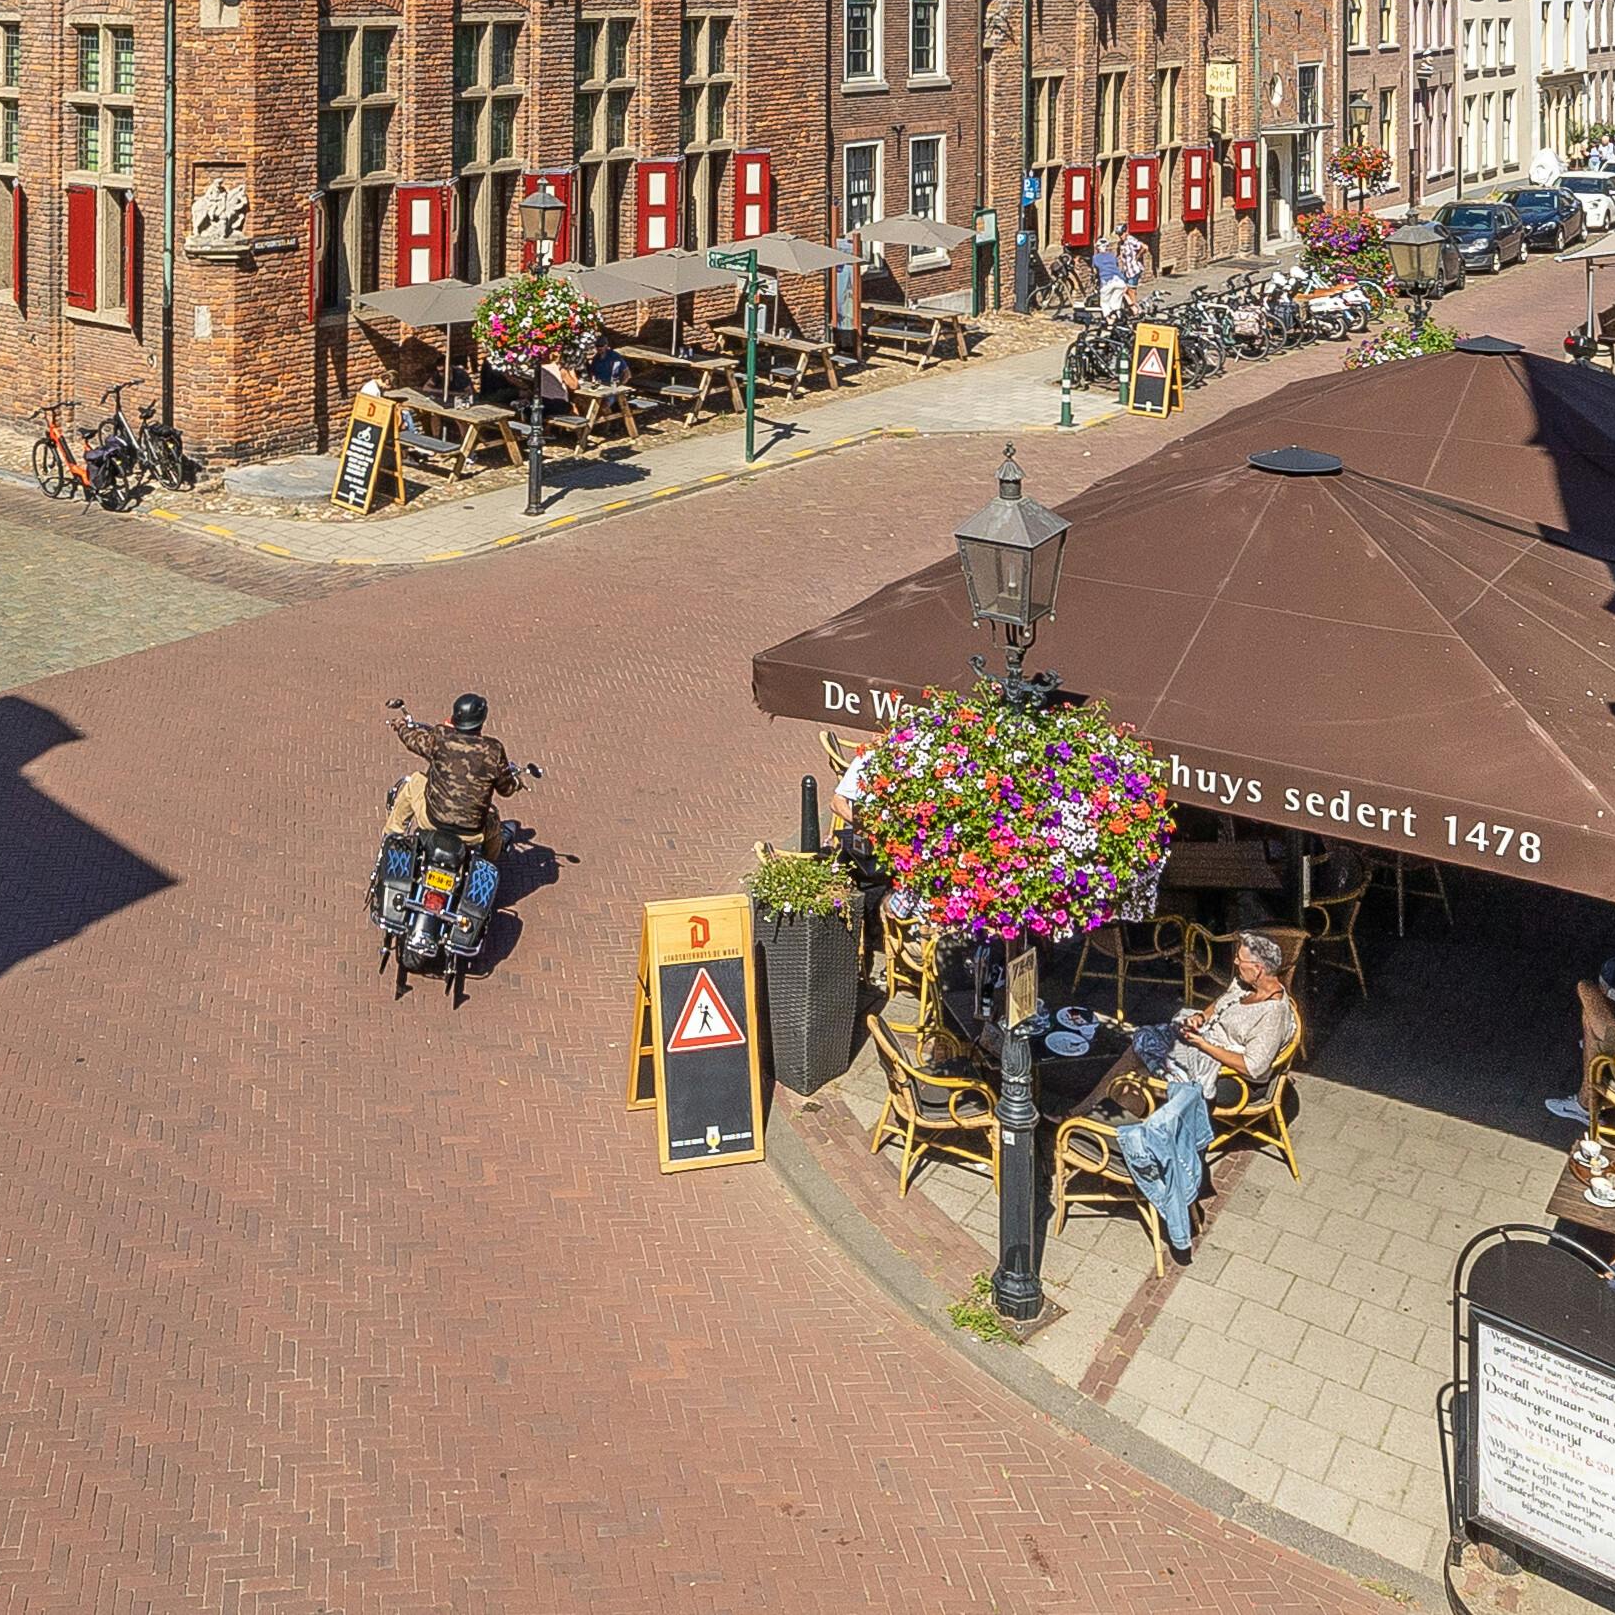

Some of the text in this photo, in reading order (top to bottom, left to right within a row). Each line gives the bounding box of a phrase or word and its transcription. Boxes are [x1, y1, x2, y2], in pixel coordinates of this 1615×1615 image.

[822, 680, 861, 715] De
[1284, 788, 1418, 837] sedert
[1443, 815, 1542, 864] 1478
[688, 915, 711, 949] D
[1483, 1360, 1528, 1392] Overall
[1534, 1384, 1583, 1414] winnaar
[1587, 1408, 1608, 1425] van
[1526, 1413, 1581, 1451] wedstrijd
